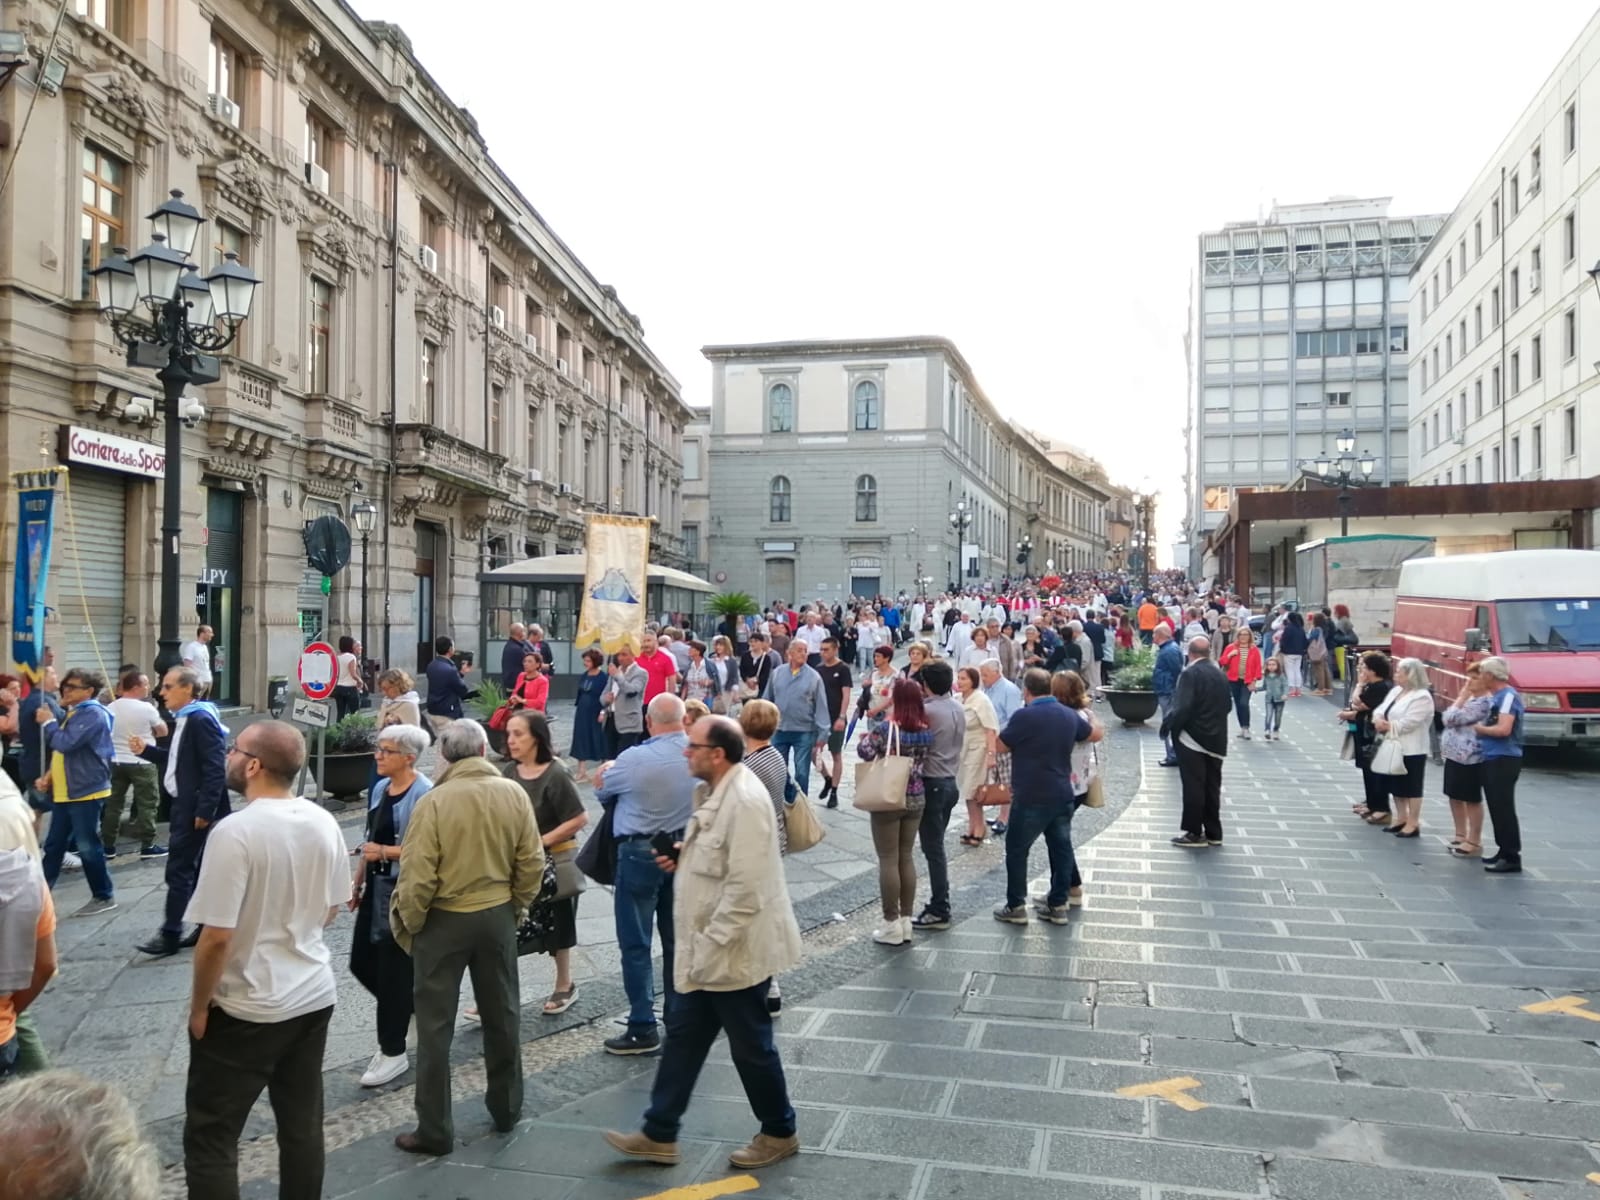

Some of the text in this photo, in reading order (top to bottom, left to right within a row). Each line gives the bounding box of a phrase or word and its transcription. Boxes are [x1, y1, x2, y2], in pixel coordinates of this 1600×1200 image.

[71, 432, 165, 473] Corriere dello Spor
[198, 568, 228, 585] LPY
